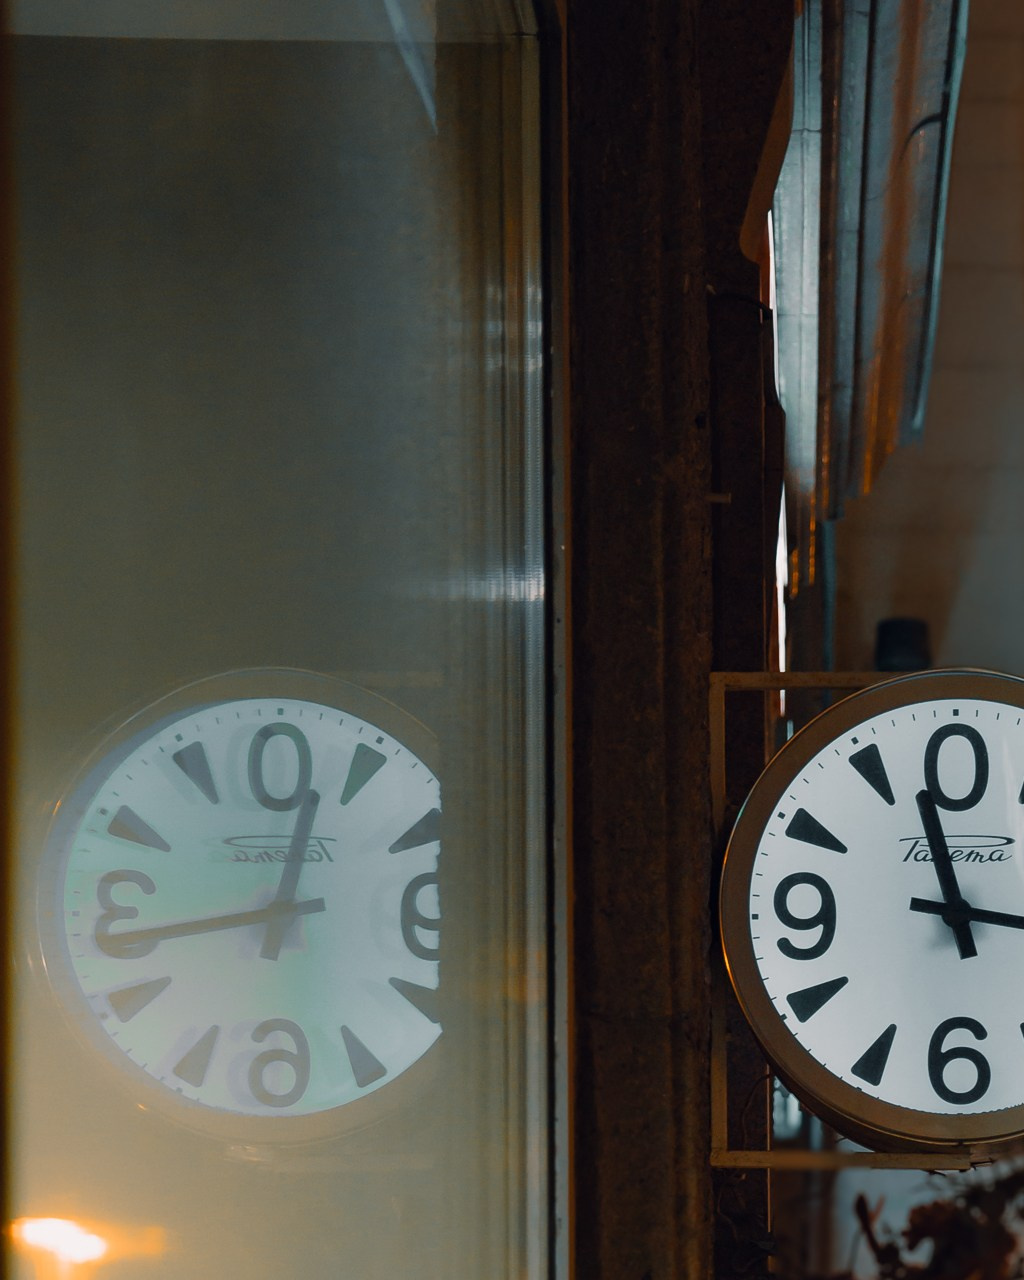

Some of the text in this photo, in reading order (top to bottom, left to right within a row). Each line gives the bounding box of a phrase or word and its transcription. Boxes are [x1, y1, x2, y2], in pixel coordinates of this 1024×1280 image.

[924, 723, 989, 812] 0
[773, 872, 837, 961] 9
[928, 1016, 991, 1105] 6
